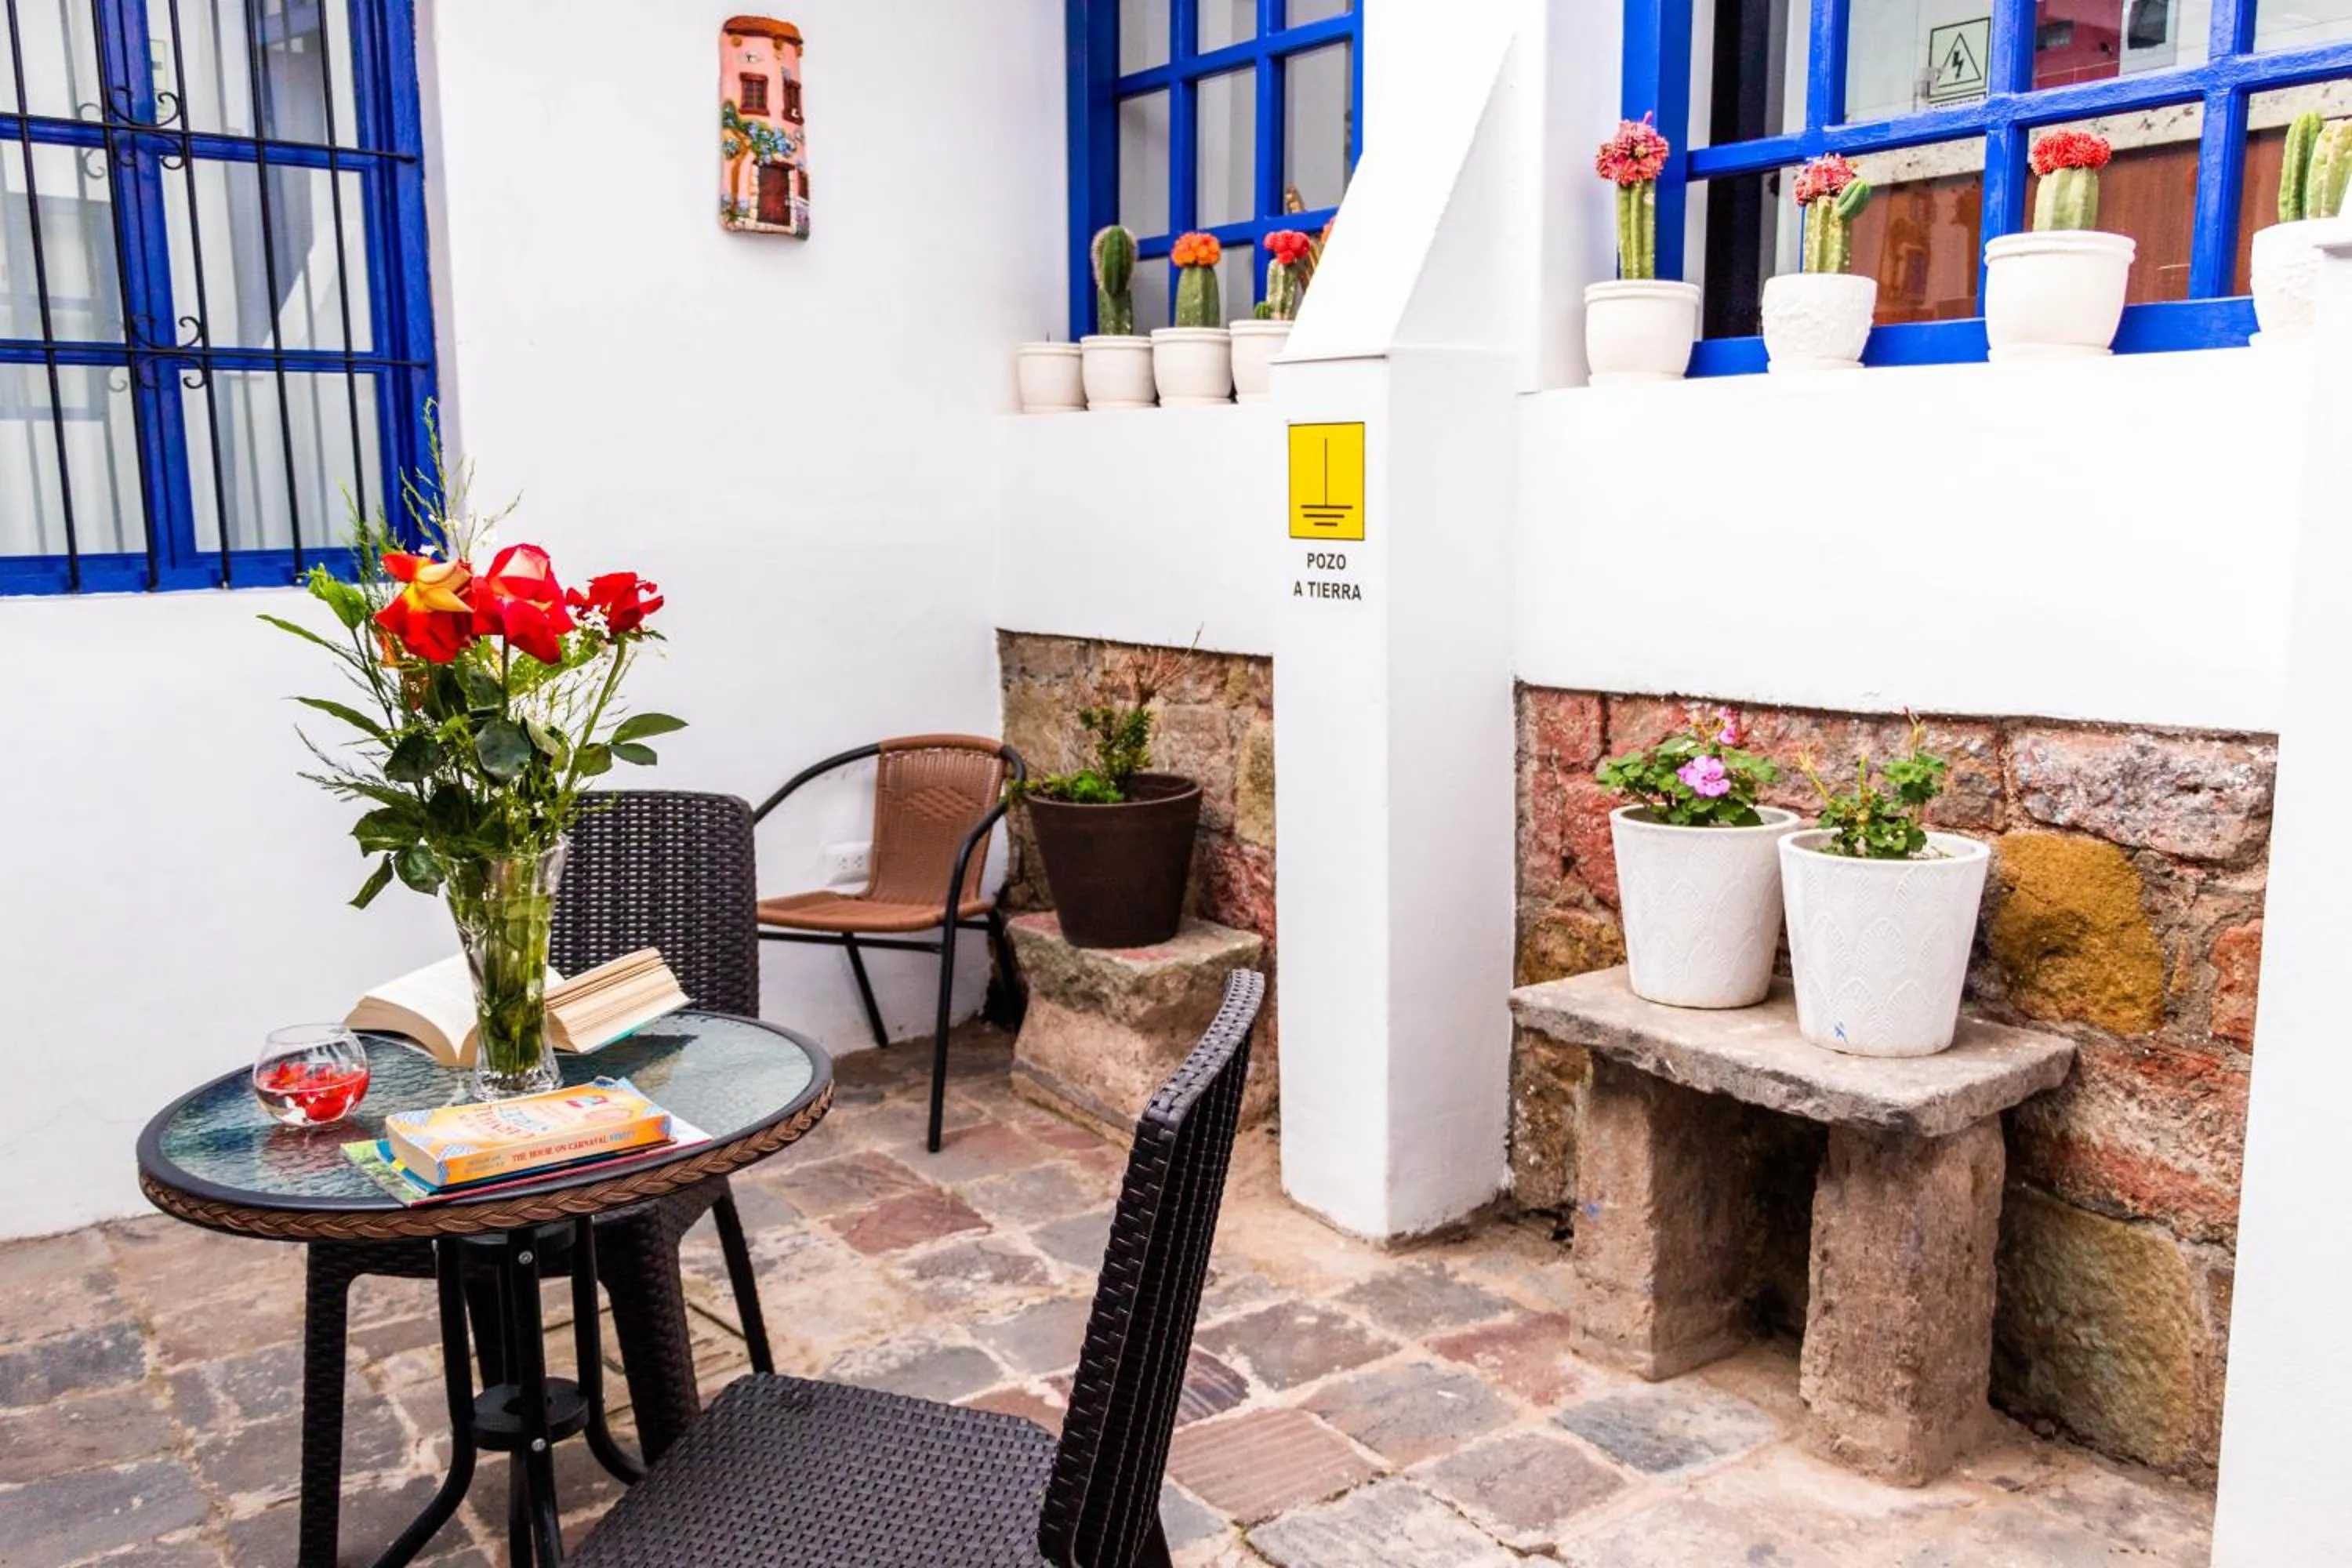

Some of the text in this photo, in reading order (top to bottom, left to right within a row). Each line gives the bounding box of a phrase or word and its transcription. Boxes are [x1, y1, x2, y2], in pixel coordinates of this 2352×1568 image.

[1307, 553, 1346, 570] POZO
[1294, 581, 1362, 601] A TIERRA
[512, 1152, 527, 1162] THE
